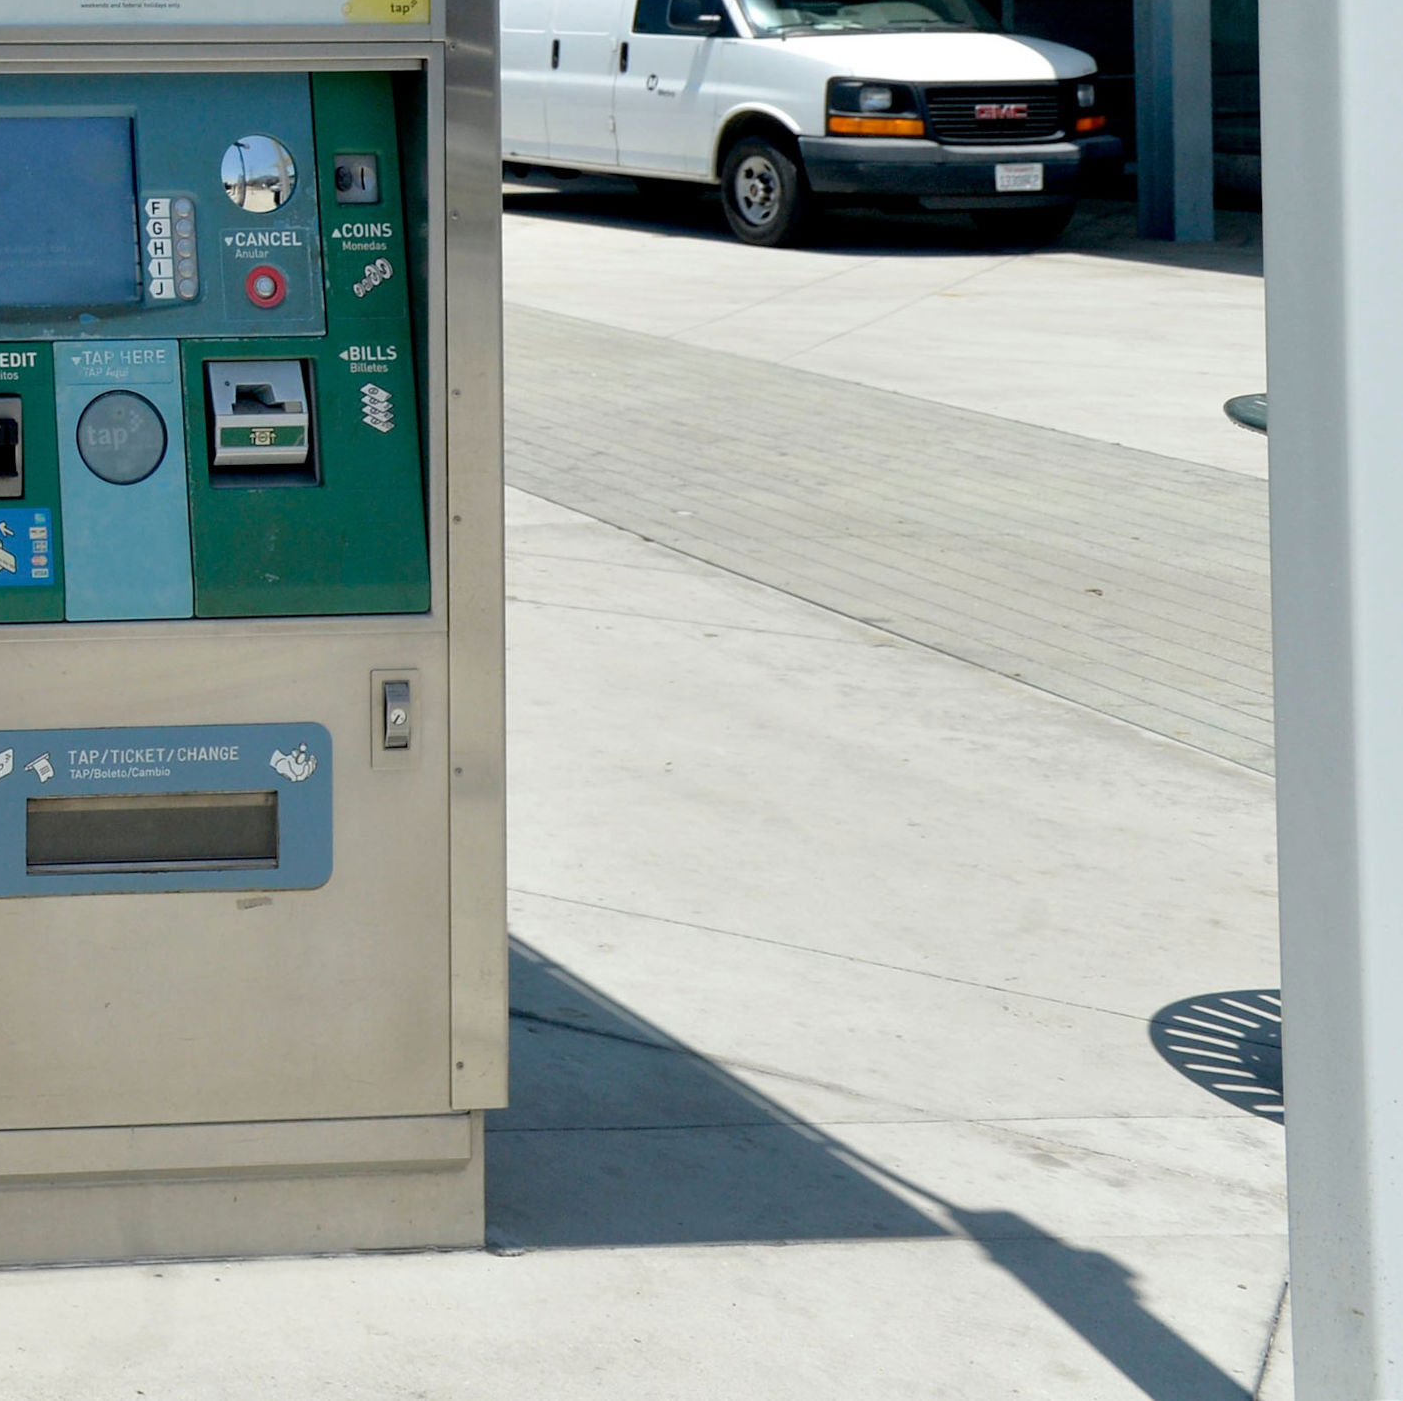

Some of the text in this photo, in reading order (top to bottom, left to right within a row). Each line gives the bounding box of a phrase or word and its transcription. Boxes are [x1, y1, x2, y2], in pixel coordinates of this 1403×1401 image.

[390, 2, 410, 14] tap
[974, 104, 1029, 119] GMC
[341, 223, 393, 238] COINS
[235, 232, 302, 246] CANCEL
[342, 241, 387, 251] Monedas
[235, 248, 270, 259] Anular
[82, 350, 166, 365] TAP HERE
[349, 346, 397, 361] BILLS
[349, 362, 389, 373] Billetes
[86, 425, 129, 450] tap
[67, 746, 240, 766] TAP/TICKET/CHANGE
[69, 767, 171, 780] TAP/Boleto/Cambio
